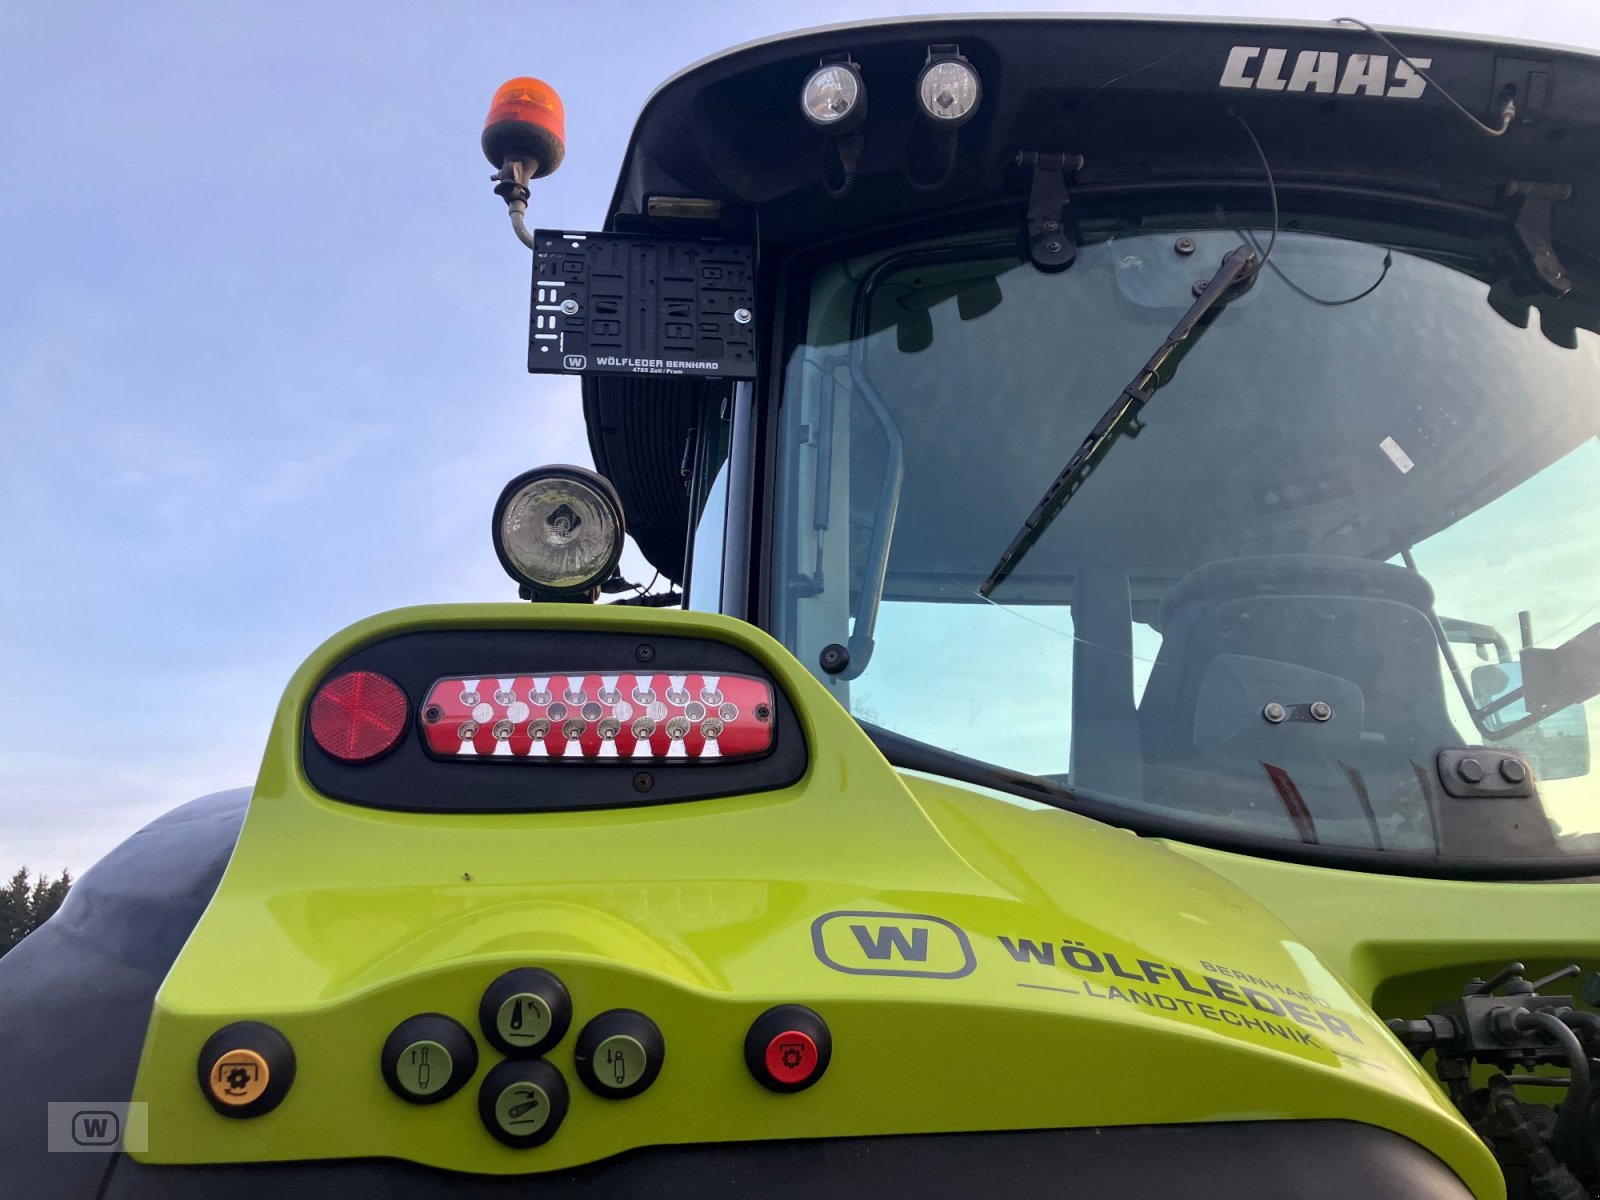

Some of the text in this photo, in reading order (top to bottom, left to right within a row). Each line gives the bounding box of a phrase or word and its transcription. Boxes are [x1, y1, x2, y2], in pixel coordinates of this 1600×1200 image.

[1219, 45, 1433, 99] CLAAS
[568, 357, 582, 368] W
[597, 356, 718, 369] WÖLFLEDER BERNHARD
[849, 925, 928, 962] W
[997, 935, 1364, 1044] WÖLFLEDER
[1199, 959, 1332, 1010] BERNHARD
[1082, 981, 1322, 1050] LANDTECHNIK
